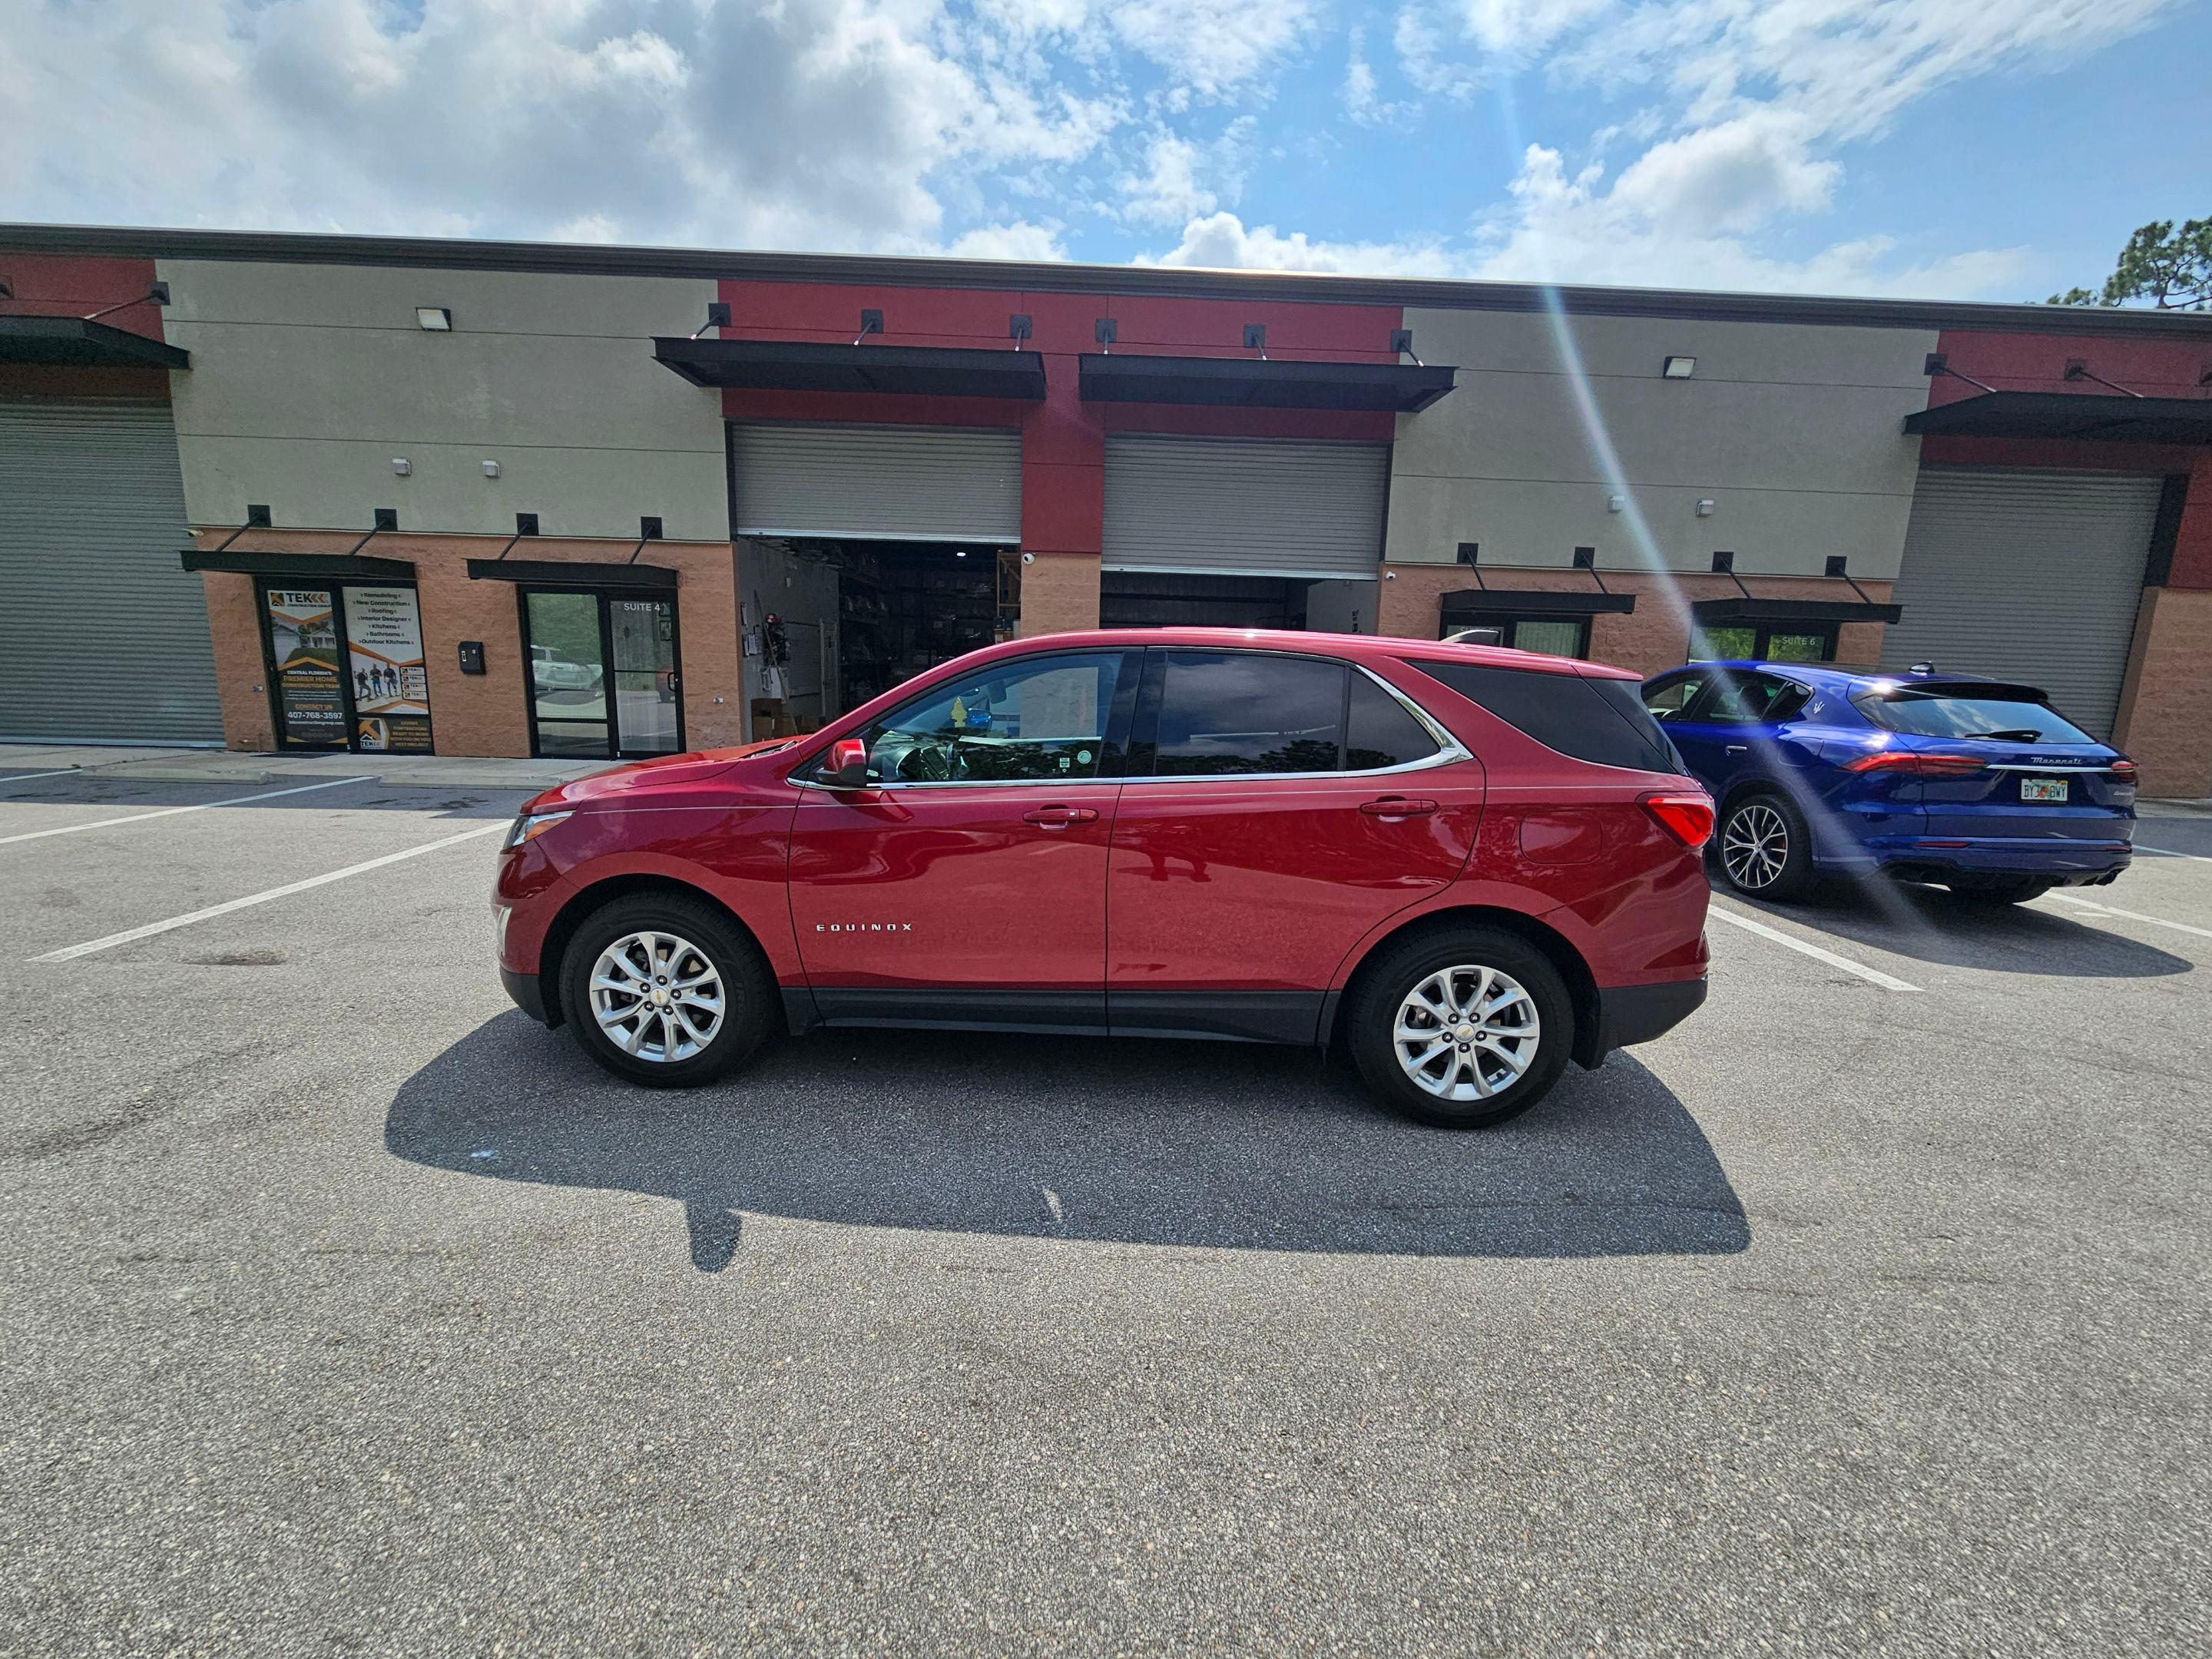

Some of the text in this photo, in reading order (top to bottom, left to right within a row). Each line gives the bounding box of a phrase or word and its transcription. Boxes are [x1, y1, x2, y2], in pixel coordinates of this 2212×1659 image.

[624, 603, 652, 611] SUITE
[1782, 637, 1808, 645] SUITE
[287, 711, 343, 720] 407-768-3597
[2030, 757, 2083, 765] Maserati
[816, 923, 912, 932] EQUINOX
